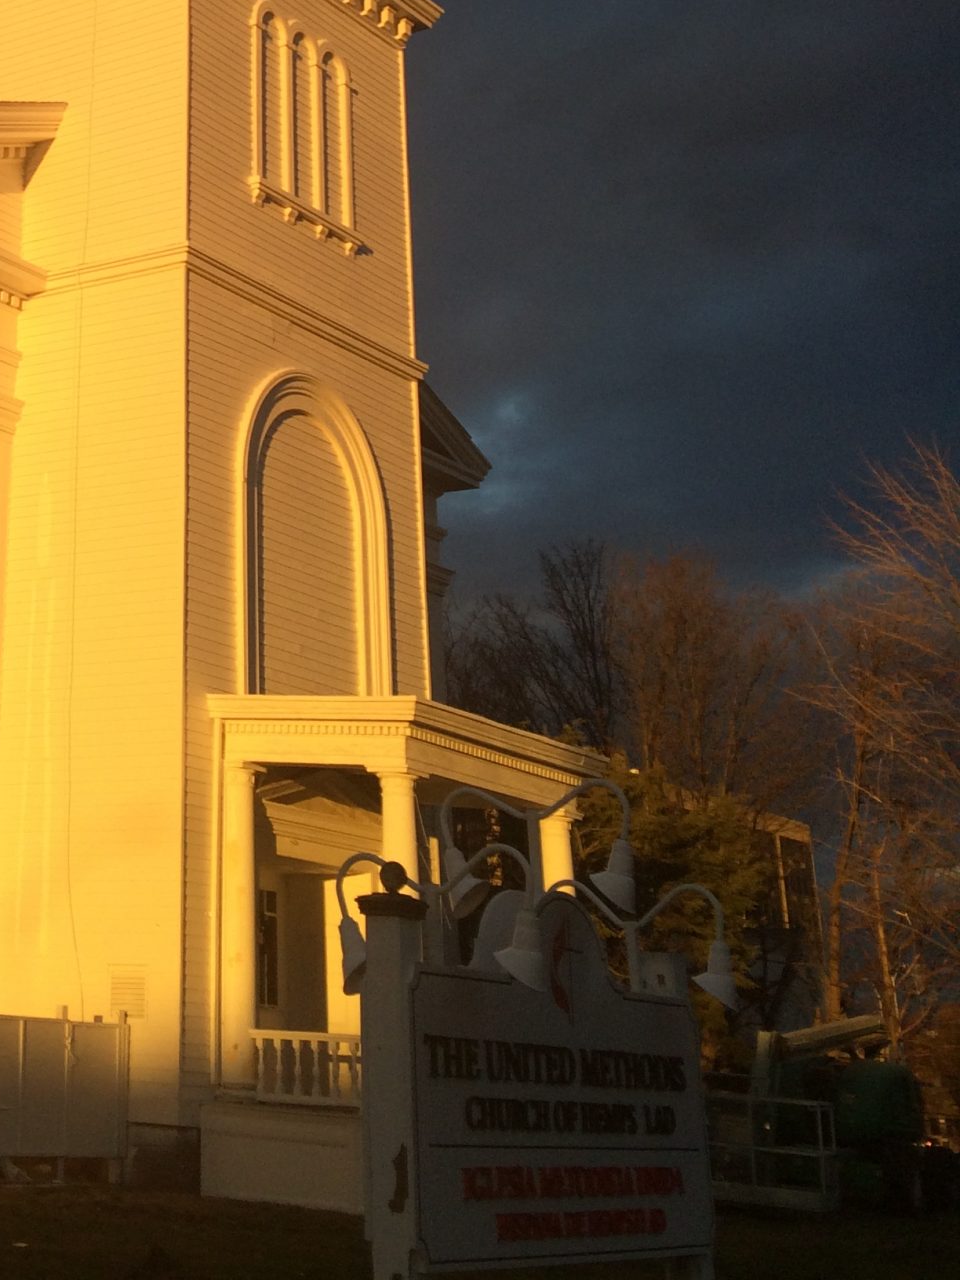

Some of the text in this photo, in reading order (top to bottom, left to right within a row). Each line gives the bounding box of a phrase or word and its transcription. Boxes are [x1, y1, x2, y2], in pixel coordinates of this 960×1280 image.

[424, 1033, 480, 1080] THE
[483, 1039, 577, 1085] UNITED
[465, 1096, 550, 1132] CHURCH
[553, 1099, 578, 1133] OF
